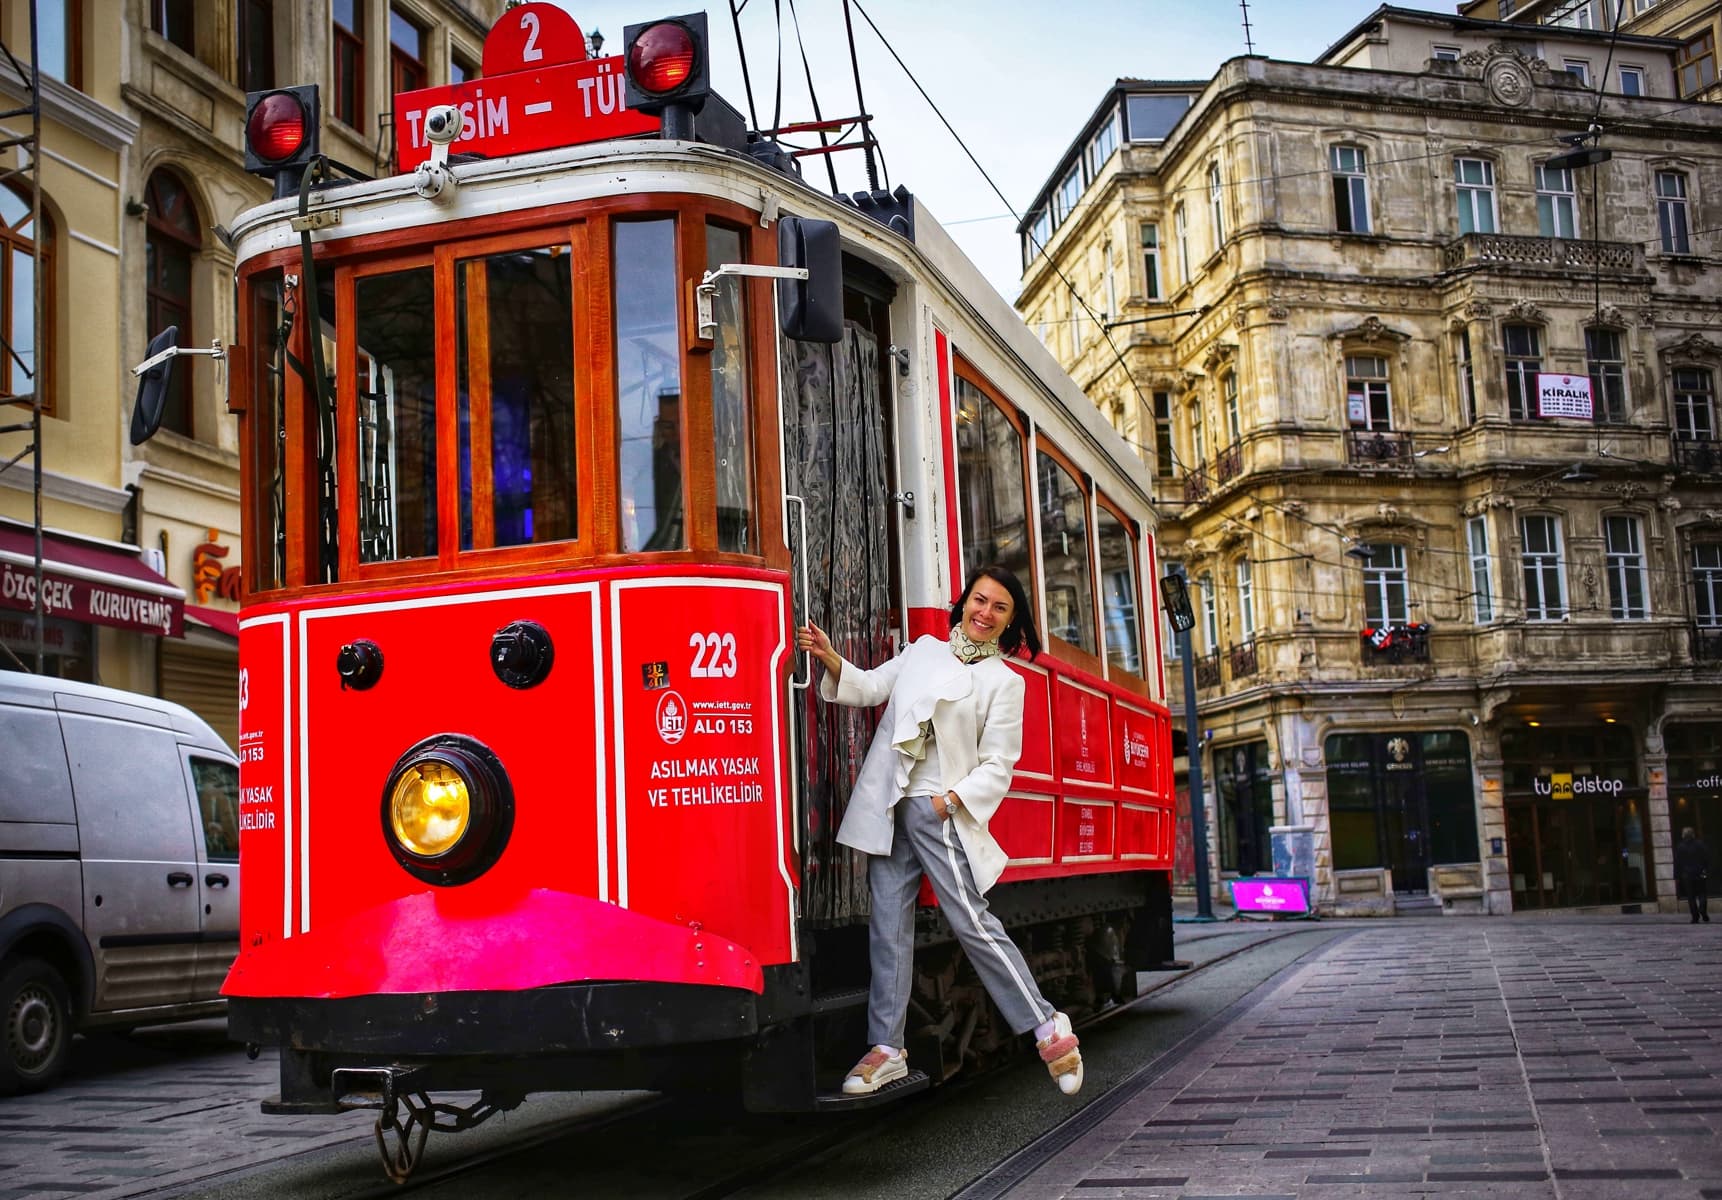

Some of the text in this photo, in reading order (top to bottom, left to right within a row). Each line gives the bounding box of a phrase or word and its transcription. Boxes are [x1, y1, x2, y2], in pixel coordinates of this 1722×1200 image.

[520, 12, 543, 62] 2
[1542, 387, 1590, 399] KİRALIK
[89, 588, 173, 635] KURUYEMİŞ
[689, 632, 737, 678] 223
[692, 701, 752, 711] www.iett.gov.tr
[693, 719, 752, 734] ALO 153
[248, 747, 264, 762] 153
[651, 757, 760, 779] ASILMAK YASAK
[246, 786, 273, 804] YASAK
[648, 780, 763, 807] VE TEHLİKELİDİR
[1534, 775, 1623, 797] tunnelstop
